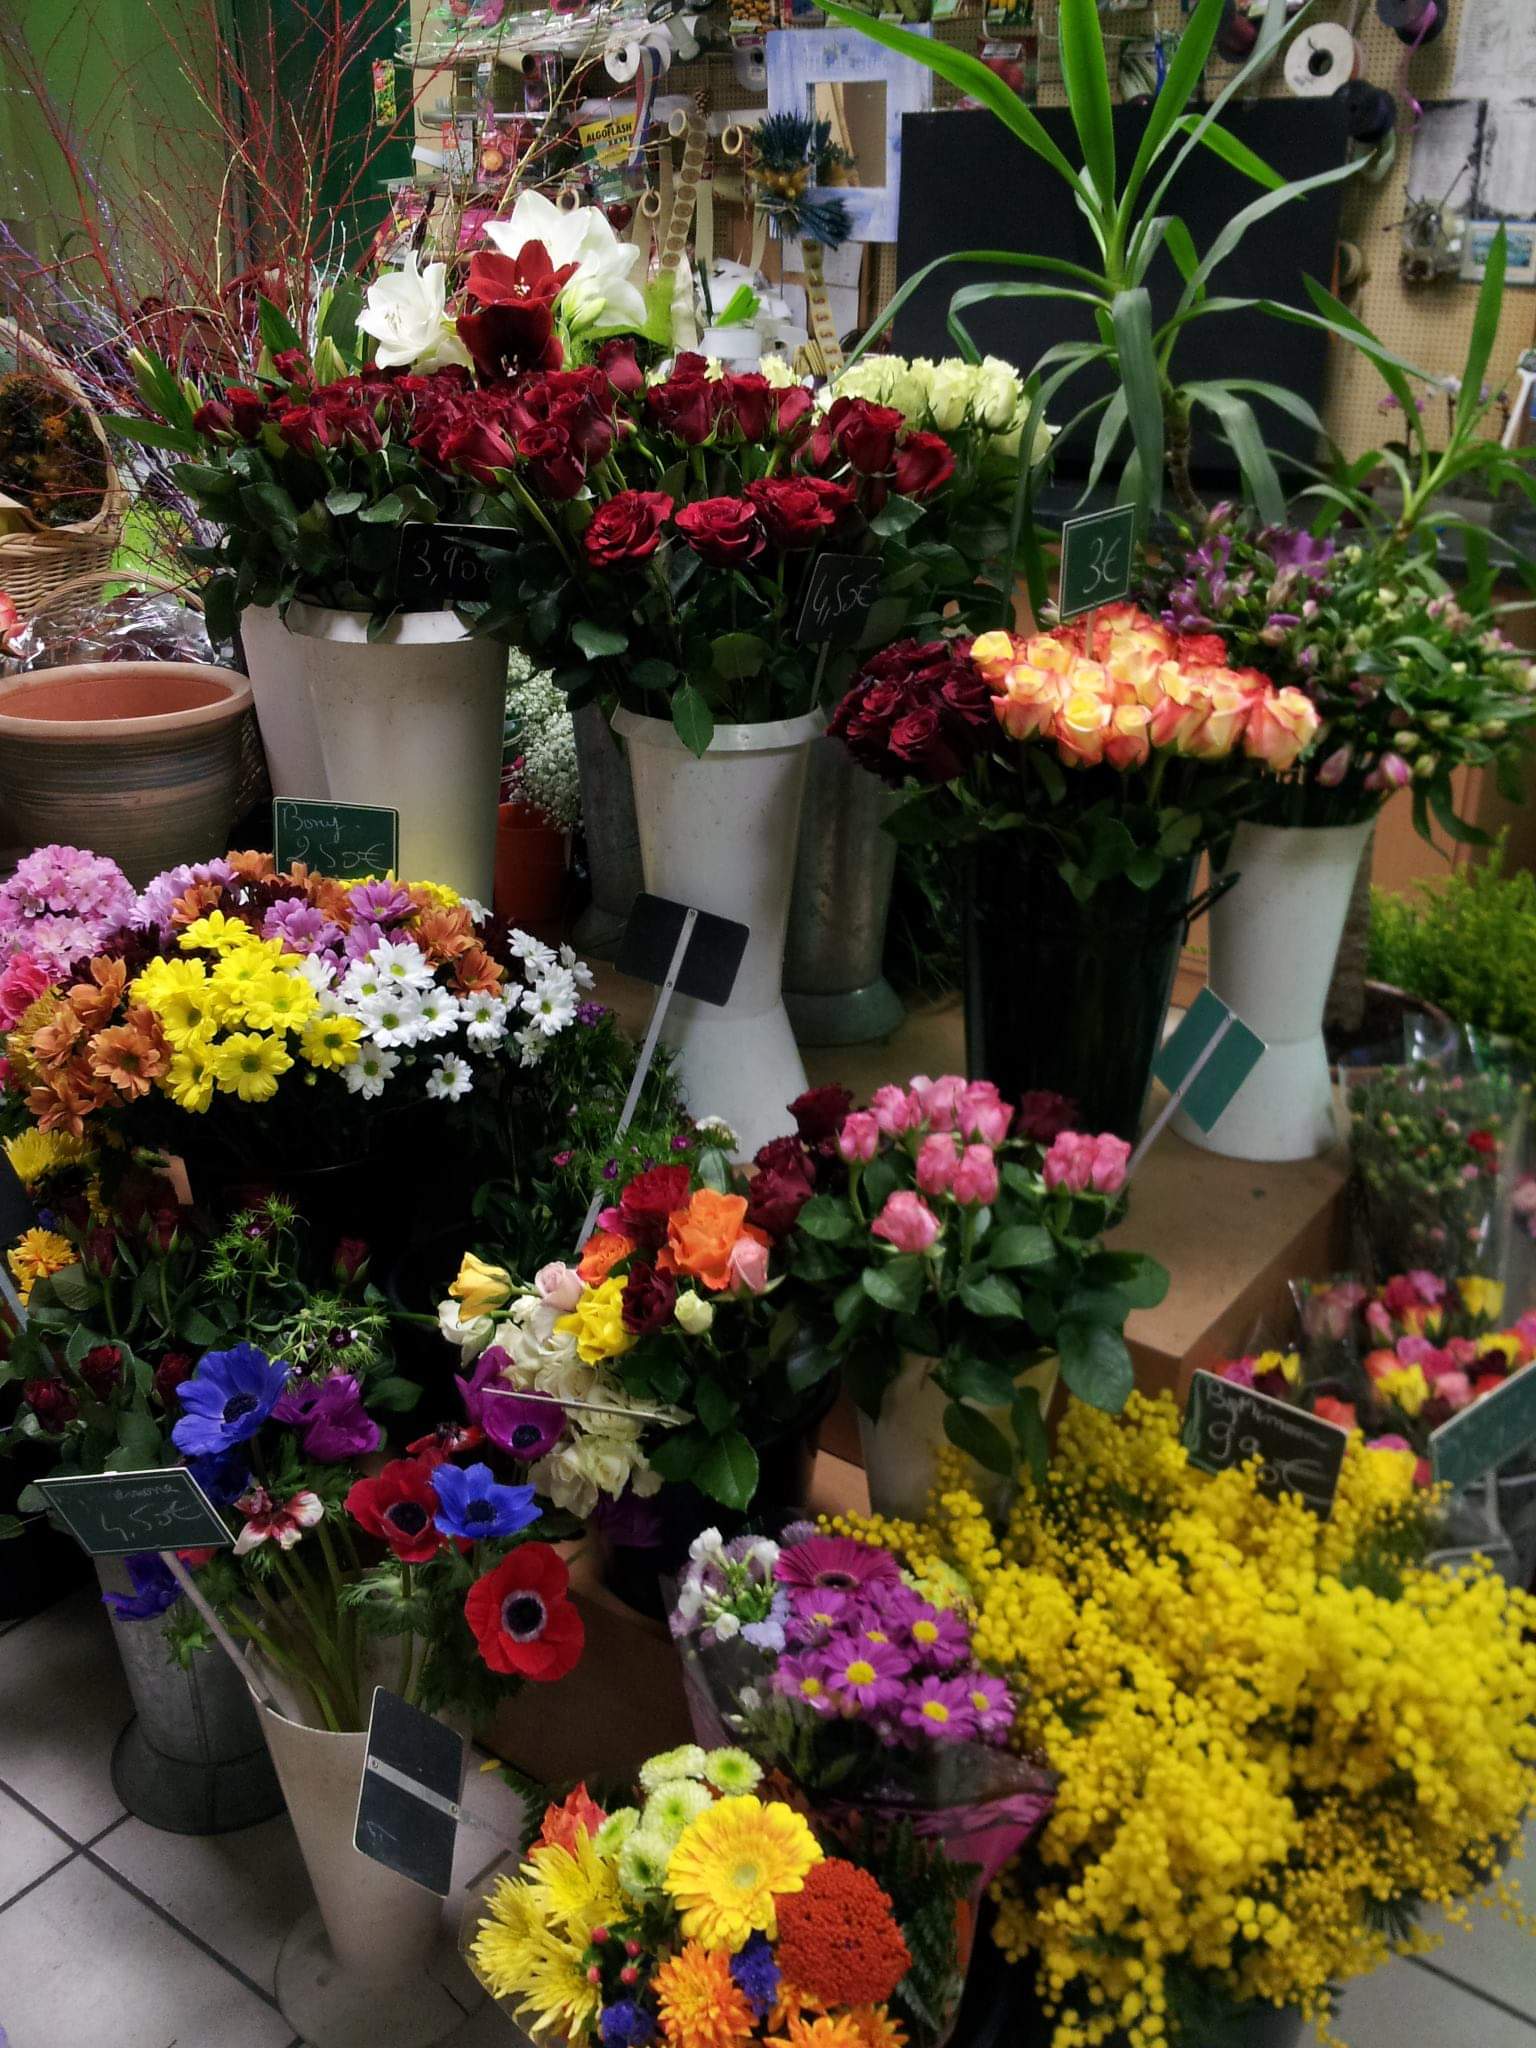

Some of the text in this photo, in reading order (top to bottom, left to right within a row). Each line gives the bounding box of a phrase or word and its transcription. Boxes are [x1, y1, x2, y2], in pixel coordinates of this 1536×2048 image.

[586, 122, 632, 142] ALGOFLASH
[1082, 537, 1122, 594] 3€
[812, 573, 878, 627] 4,50€
